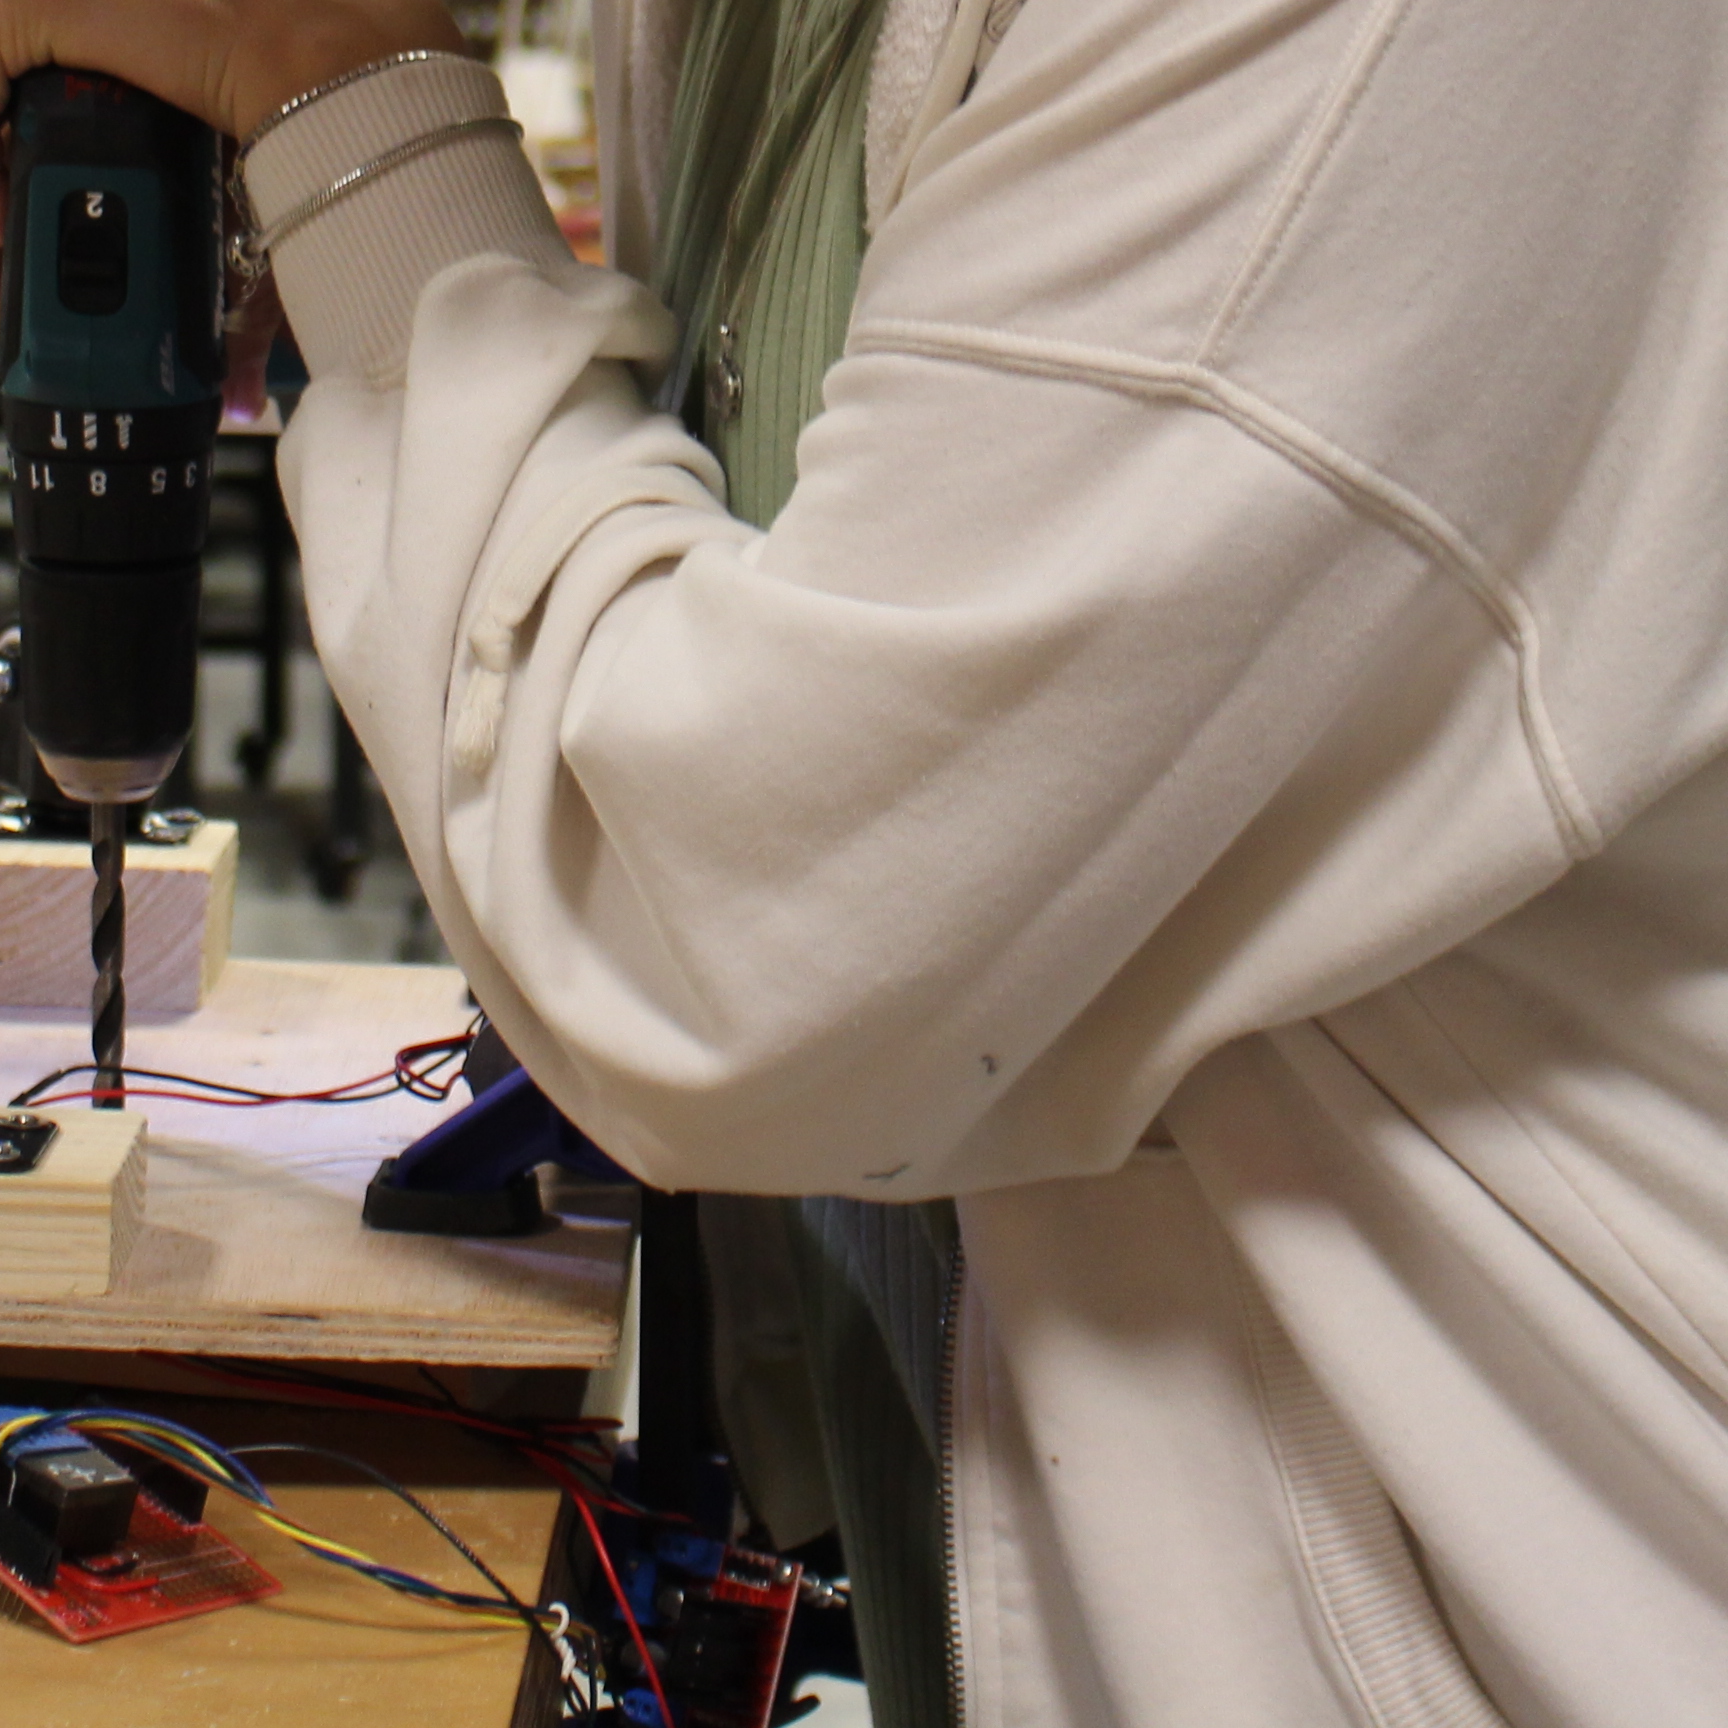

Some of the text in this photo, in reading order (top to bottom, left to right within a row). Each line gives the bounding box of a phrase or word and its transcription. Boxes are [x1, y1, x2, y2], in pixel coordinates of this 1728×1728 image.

[86, 191, 103, 218] 2
[30, 462, 55, 492] 11
[90, 470, 108, 497] 8
[151, 468, 167, 495] 5
